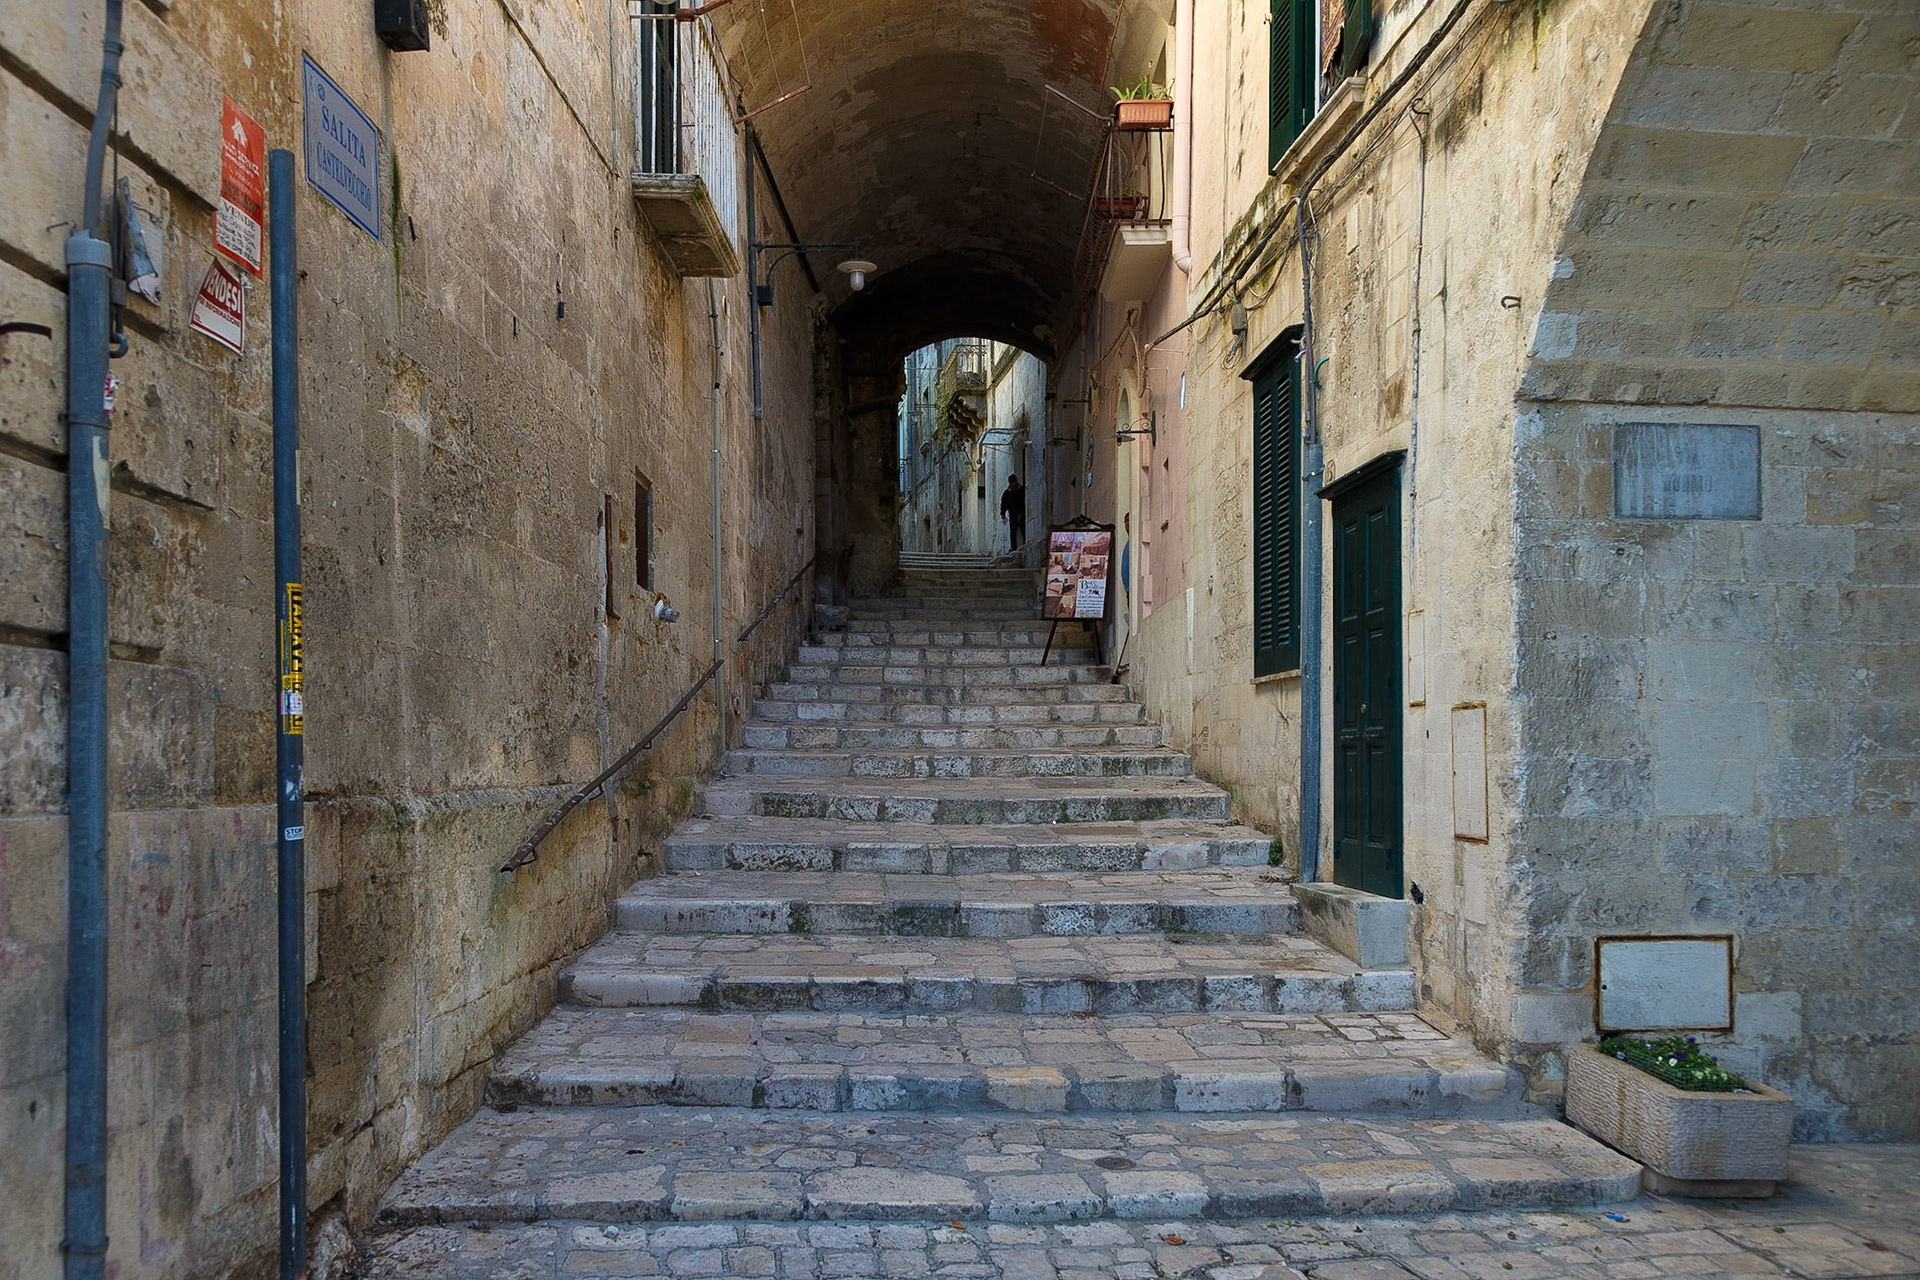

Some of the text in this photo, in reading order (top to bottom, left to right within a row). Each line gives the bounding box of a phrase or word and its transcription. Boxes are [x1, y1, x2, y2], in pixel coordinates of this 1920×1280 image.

[321, 105, 367, 168] SALITA
[316, 141, 372, 212] CASTELVECCHIO
[223, 201, 256, 232] VENDE
[203, 264, 241, 314] VENDESI
